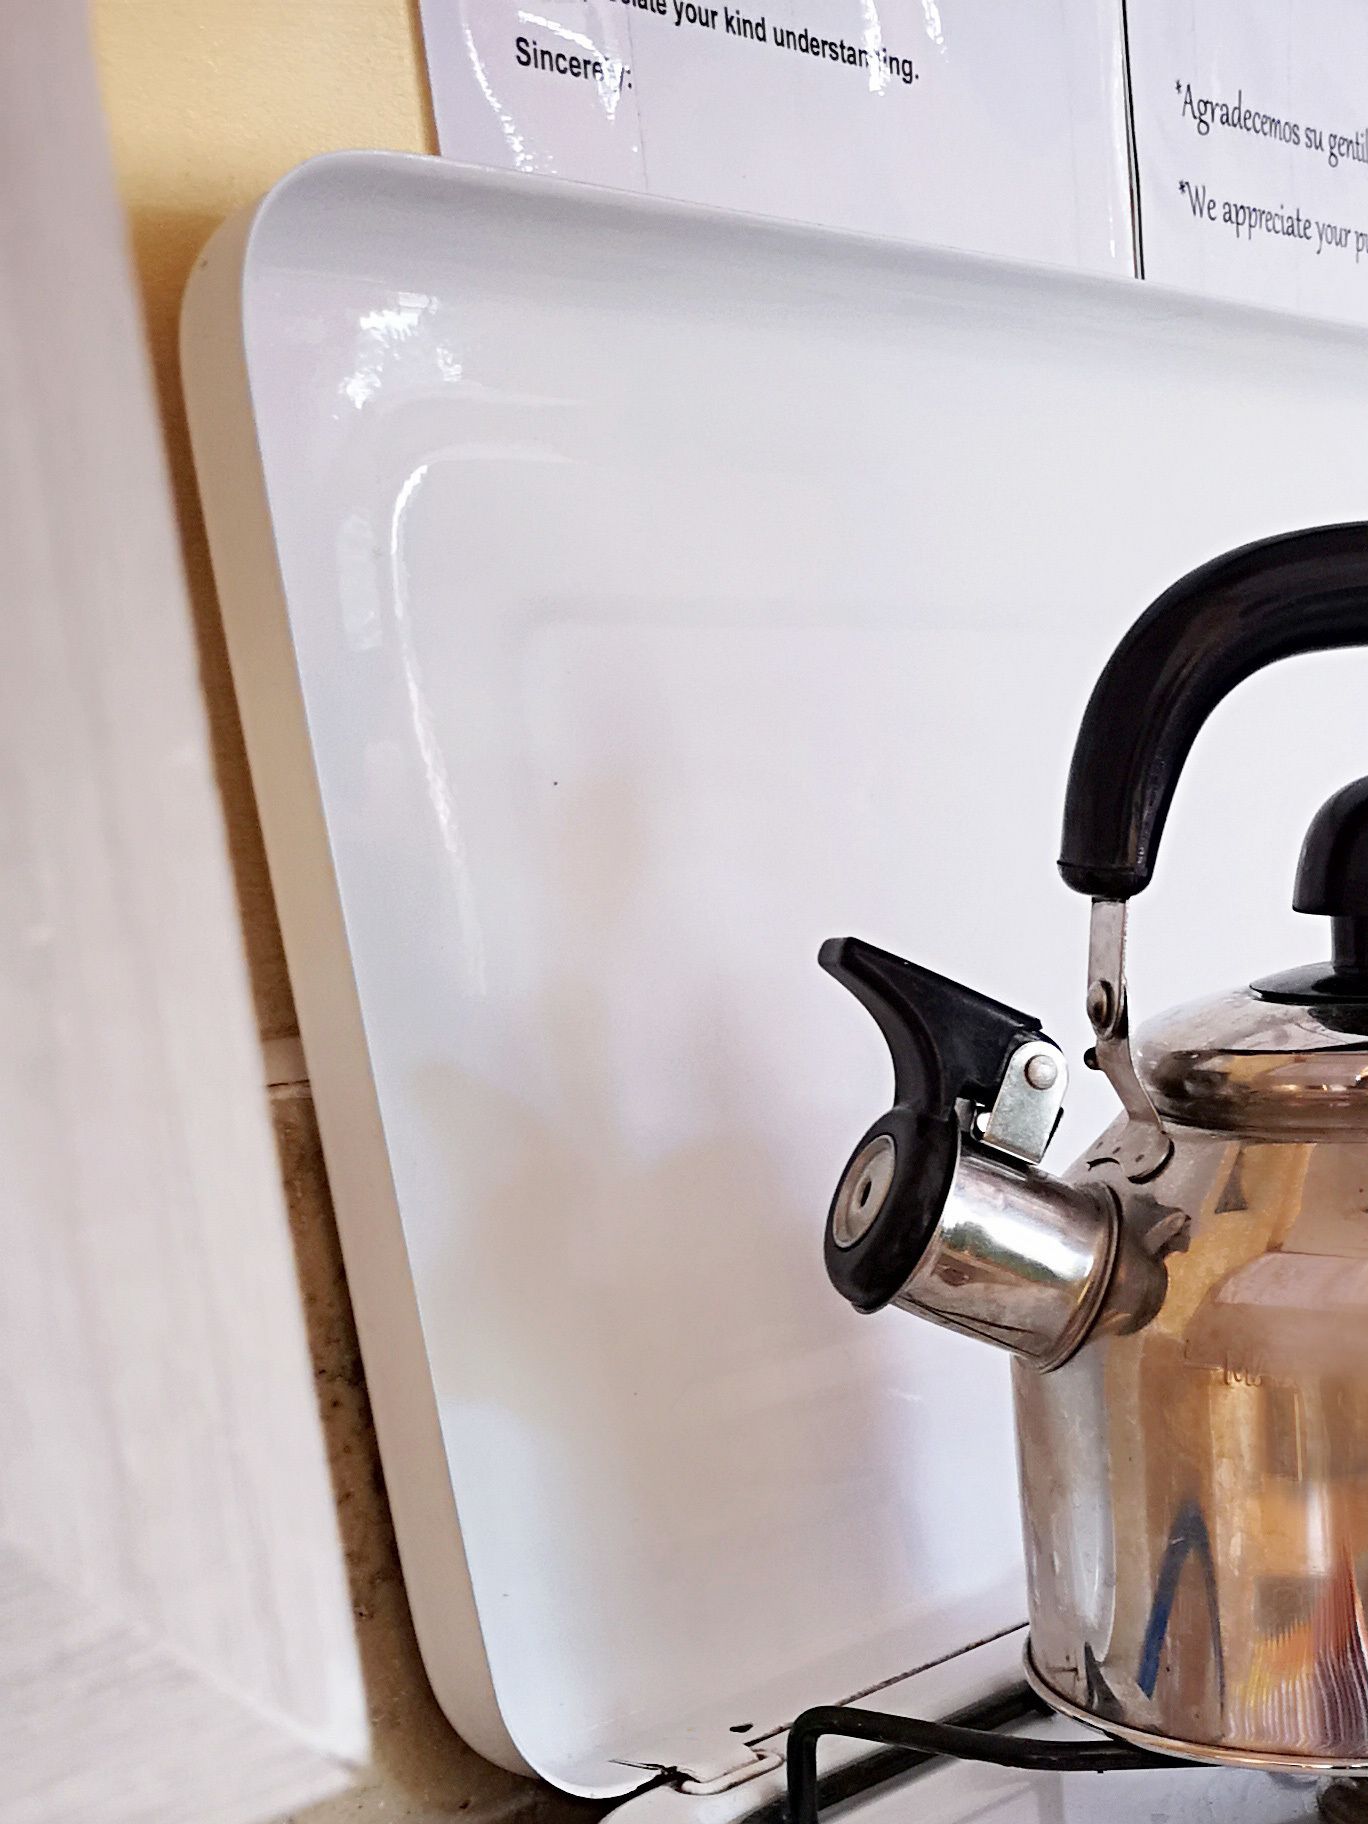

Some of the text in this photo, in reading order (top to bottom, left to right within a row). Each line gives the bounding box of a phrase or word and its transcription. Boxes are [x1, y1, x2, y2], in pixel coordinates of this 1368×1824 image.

[673, 1, 717, 27] your
[724, 10, 768, 42] kind
[772, 26, 920, 84] understaning.
[1305, 126, 1325, 152] su
[1222, 200, 1312, 241] appreciate
[1315, 221, 1351, 255] your
